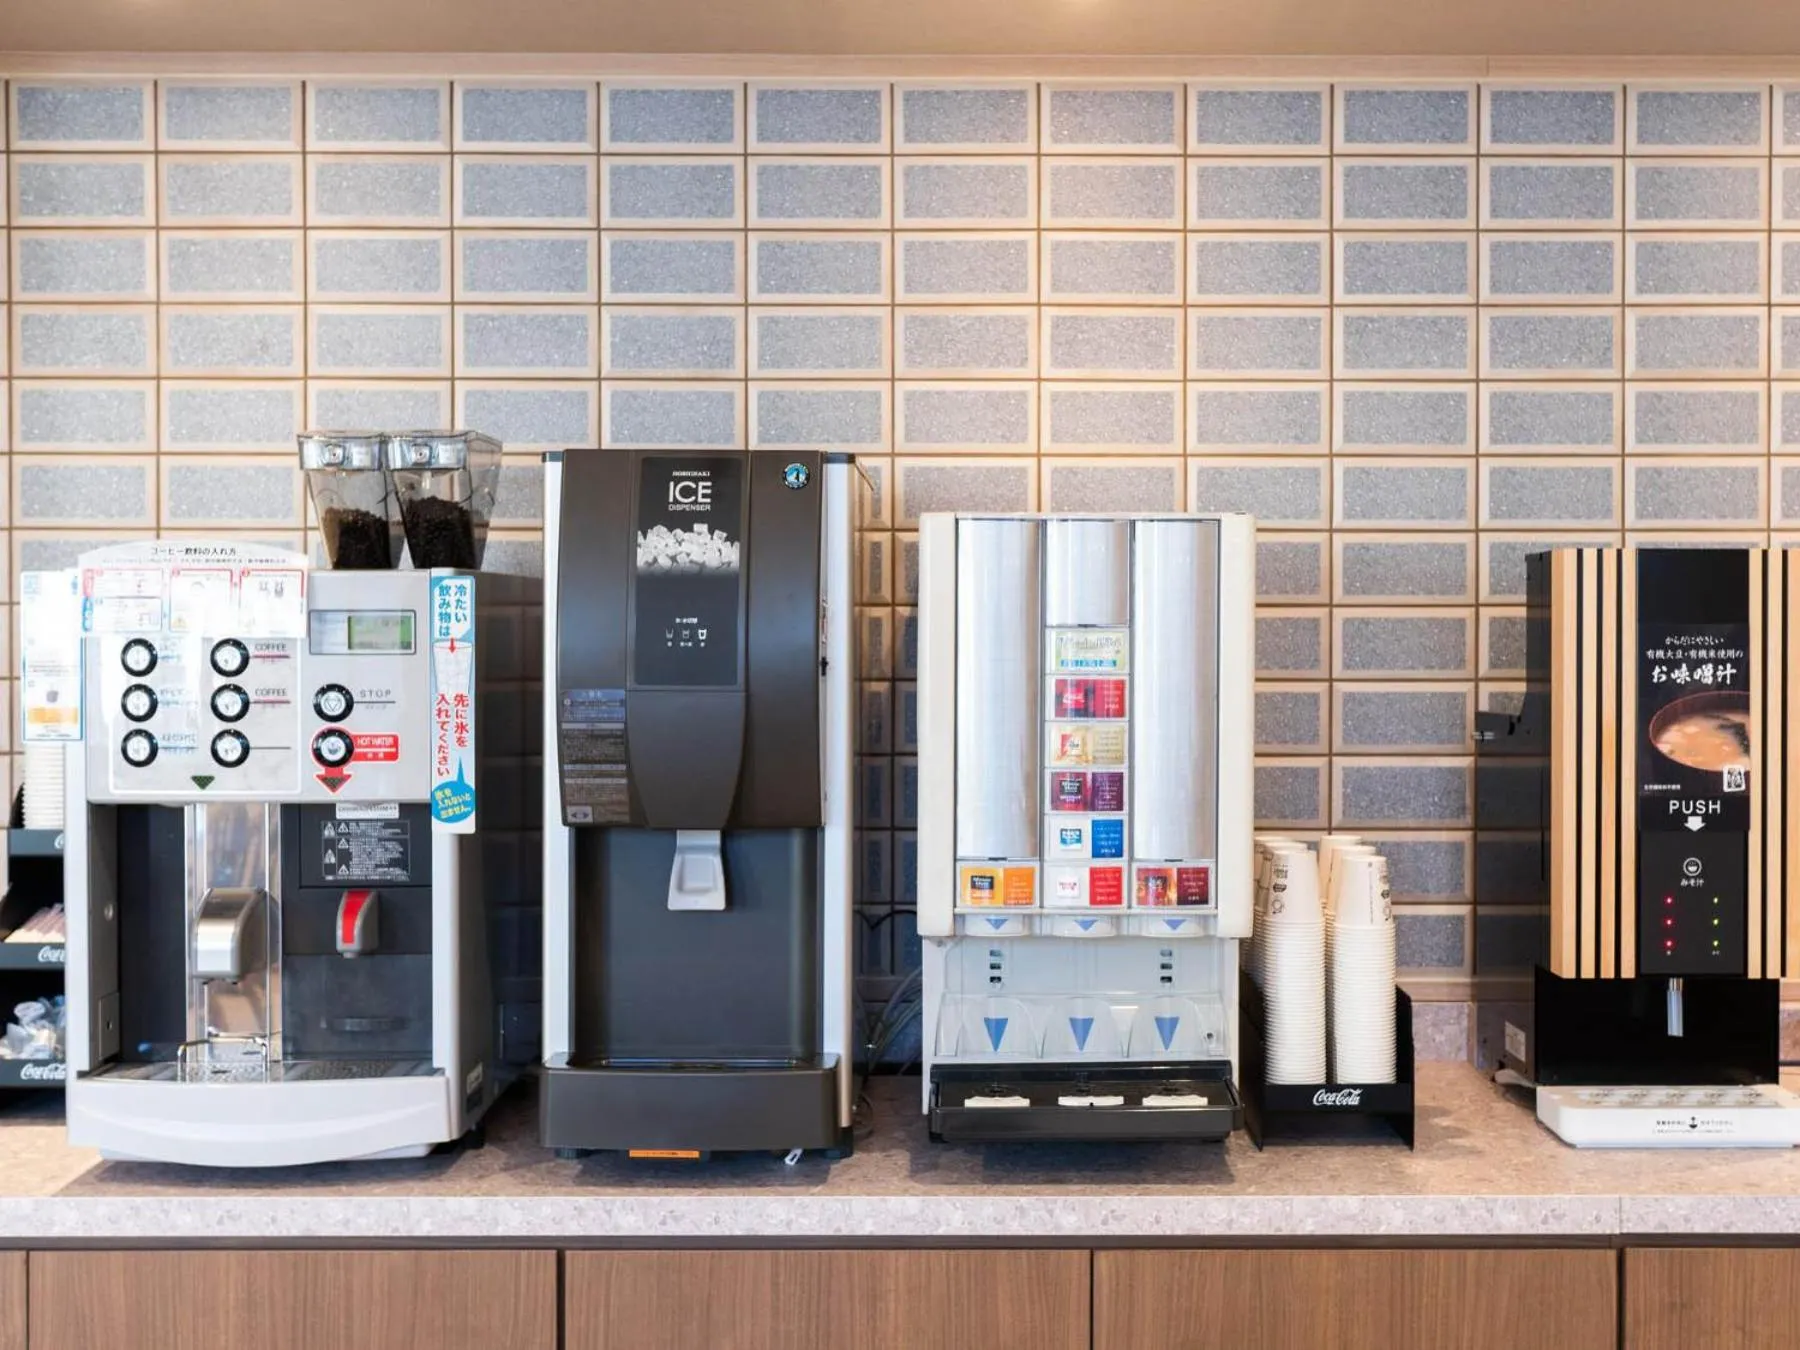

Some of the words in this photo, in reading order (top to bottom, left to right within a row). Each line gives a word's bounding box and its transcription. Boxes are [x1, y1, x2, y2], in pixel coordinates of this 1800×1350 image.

[669, 481, 713, 503] ICE
[668, 503, 712, 511] DISPENSER
[438, 583, 452, 638] 飲み物は
[454, 584, 468, 622] 冷たい
[254, 642, 287, 651] COFFEE
[1665, 635, 1724, 646] からだにやさしい
[1651, 662, 1737, 685] お味噌汁
[254, 688, 287, 696] COFFEE
[360, 689, 392, 698] STOP
[453, 692, 470, 748] 先に氷を
[435, 692, 451, 778] 入れてください
[1669, 800, 1721, 814] PUSH
